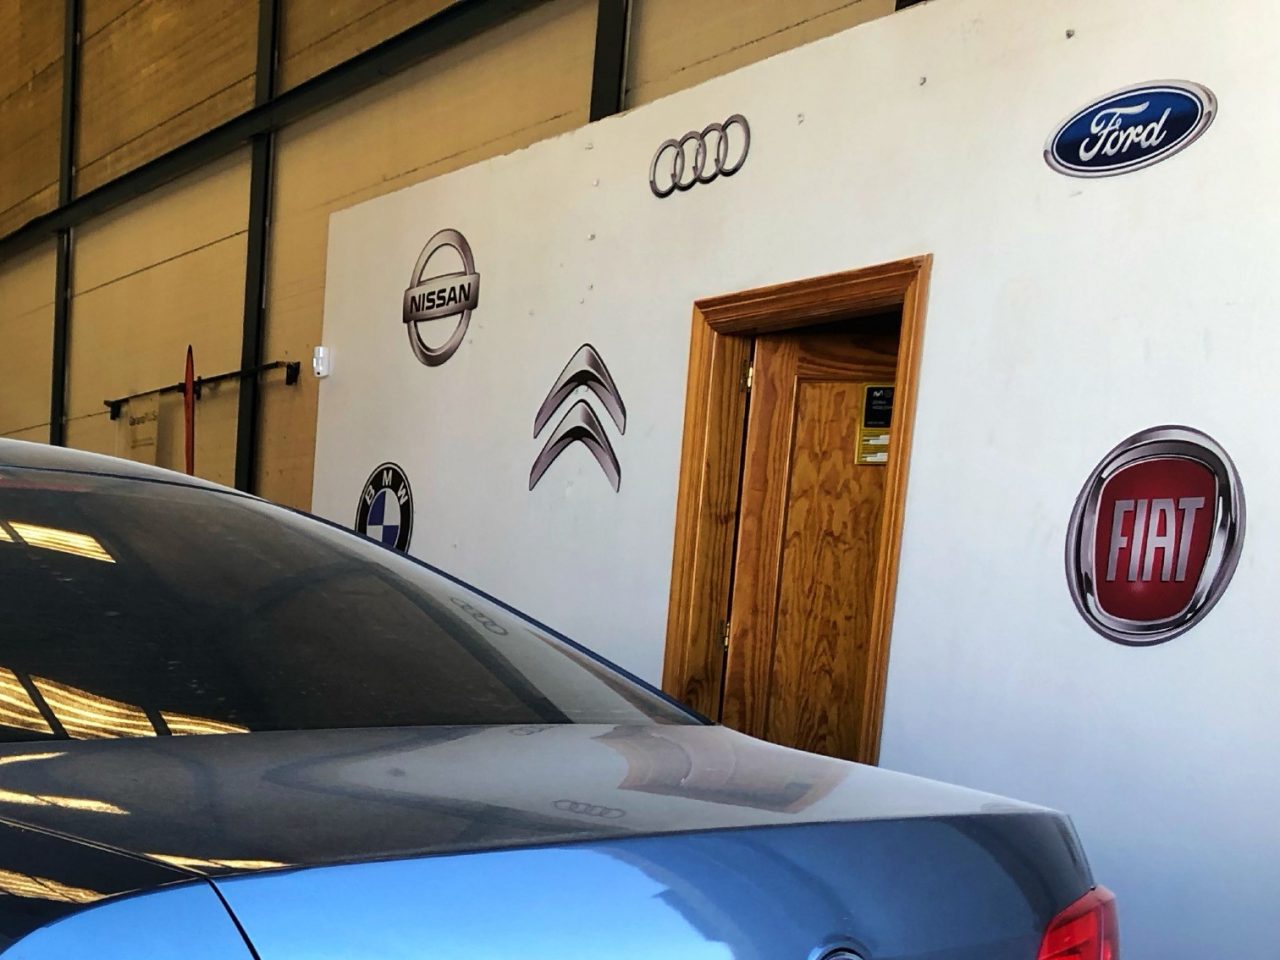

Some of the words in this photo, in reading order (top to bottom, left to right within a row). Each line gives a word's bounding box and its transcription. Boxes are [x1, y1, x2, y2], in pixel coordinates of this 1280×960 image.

[1078, 101, 1172, 162] Ford
[409, 282, 471, 314] NISSAN
[365, 469, 408, 506] BMW
[1106, 496, 1206, 582] FIAT
